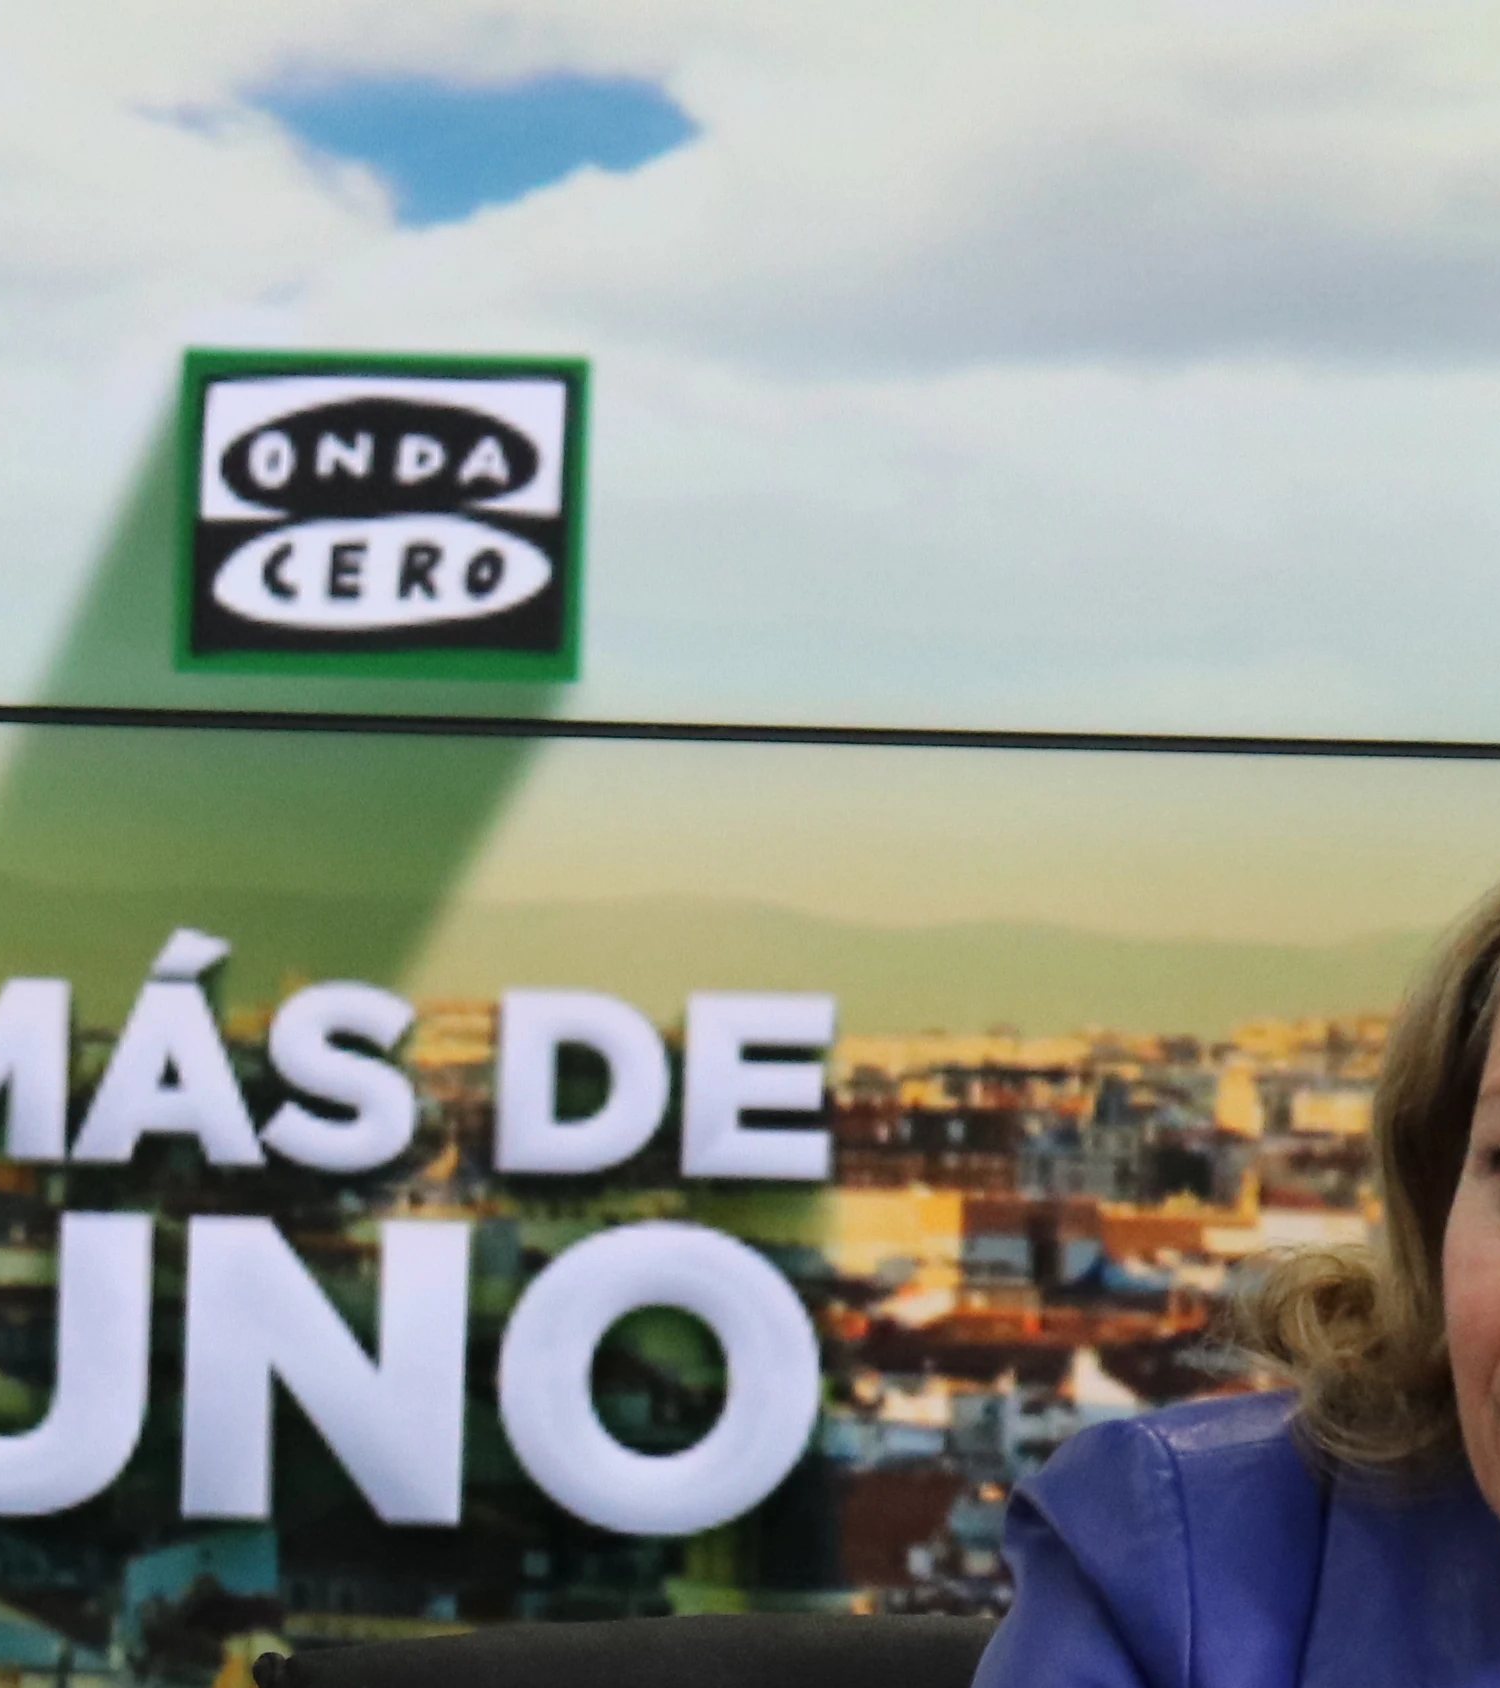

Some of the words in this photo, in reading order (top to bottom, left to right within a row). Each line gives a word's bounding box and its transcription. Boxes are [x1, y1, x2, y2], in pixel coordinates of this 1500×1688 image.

[246, 429, 512, 490] ONDA
[261, 539, 507, 601] CERO
[495, 990, 838, 1183] DE
